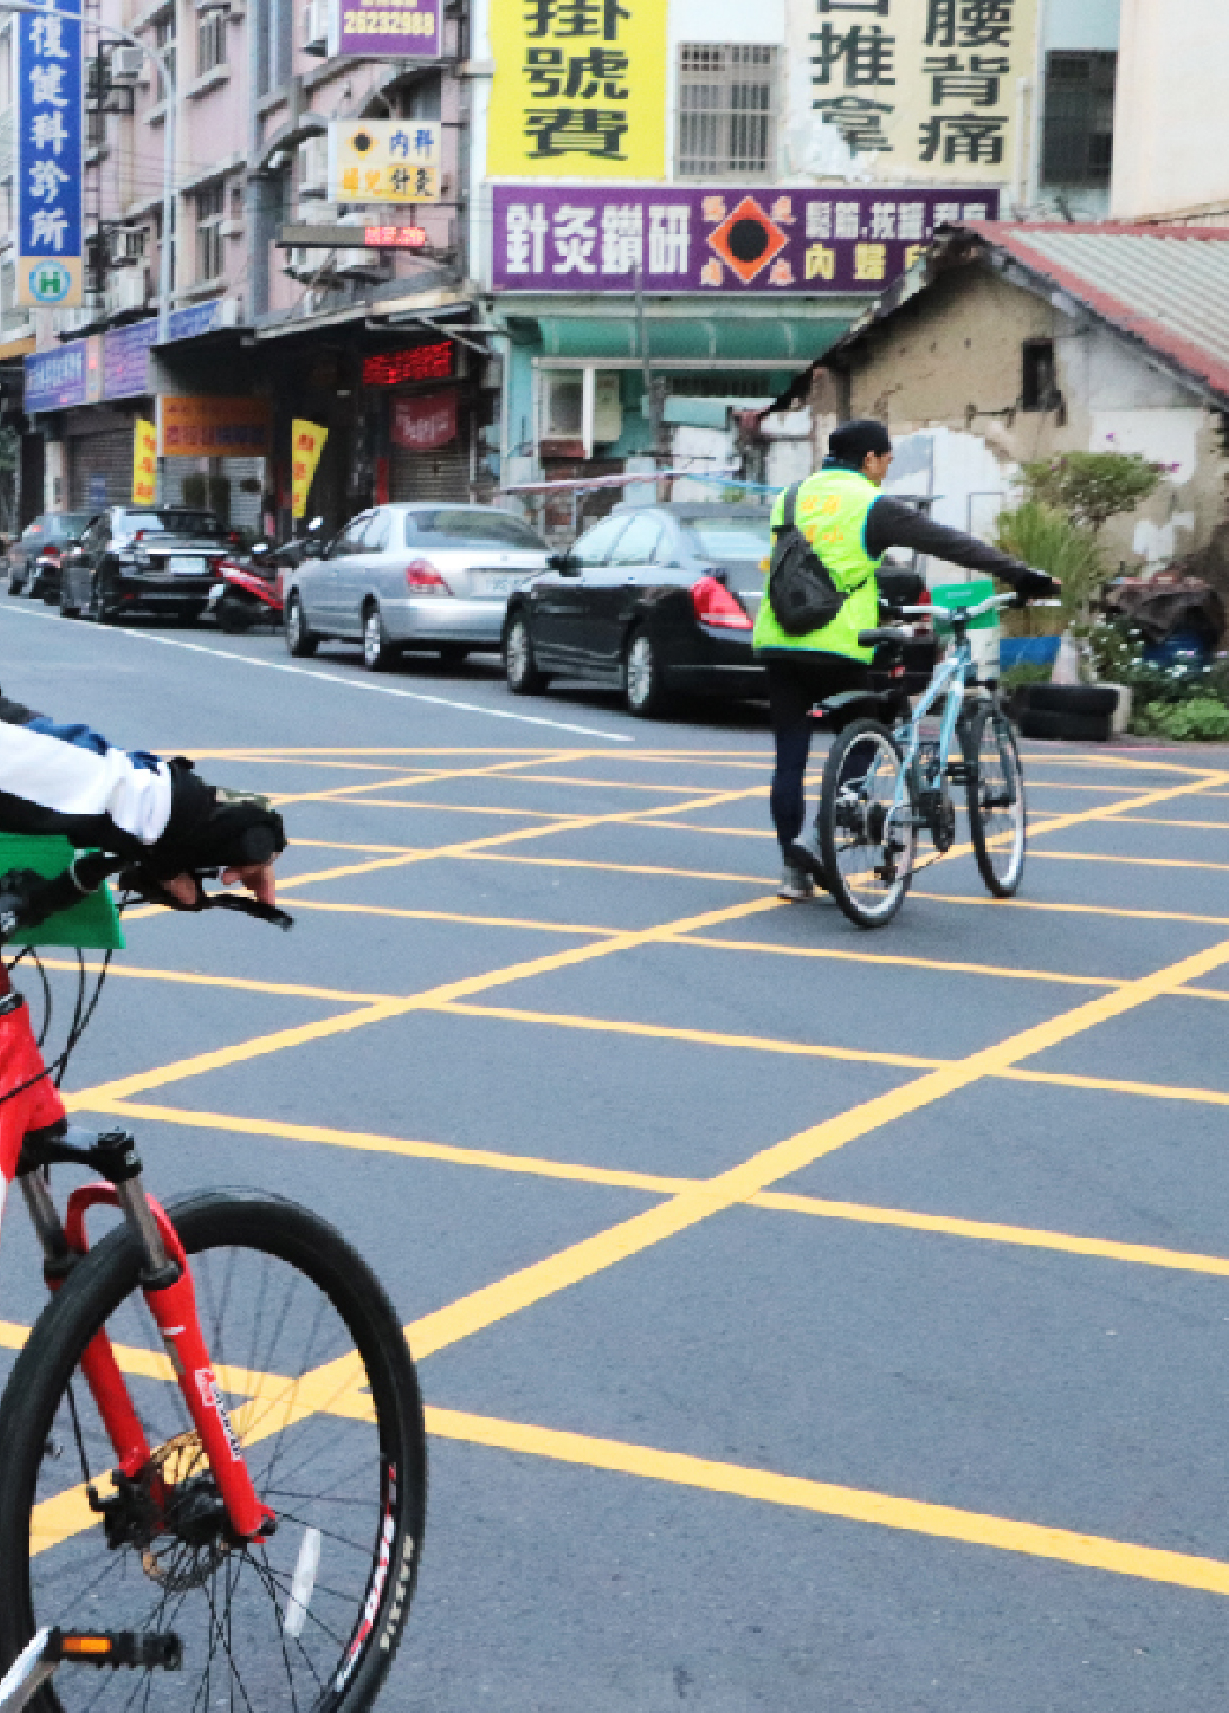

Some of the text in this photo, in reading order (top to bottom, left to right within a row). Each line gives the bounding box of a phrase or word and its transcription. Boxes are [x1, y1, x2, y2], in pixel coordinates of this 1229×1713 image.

[28, 15, 69, 252] 復健科診所
[522, 0, 631, 162] 掛號費
[809, 0, 896, 160] 推拿
[917, 0, 1014, 165] 腰背痛
